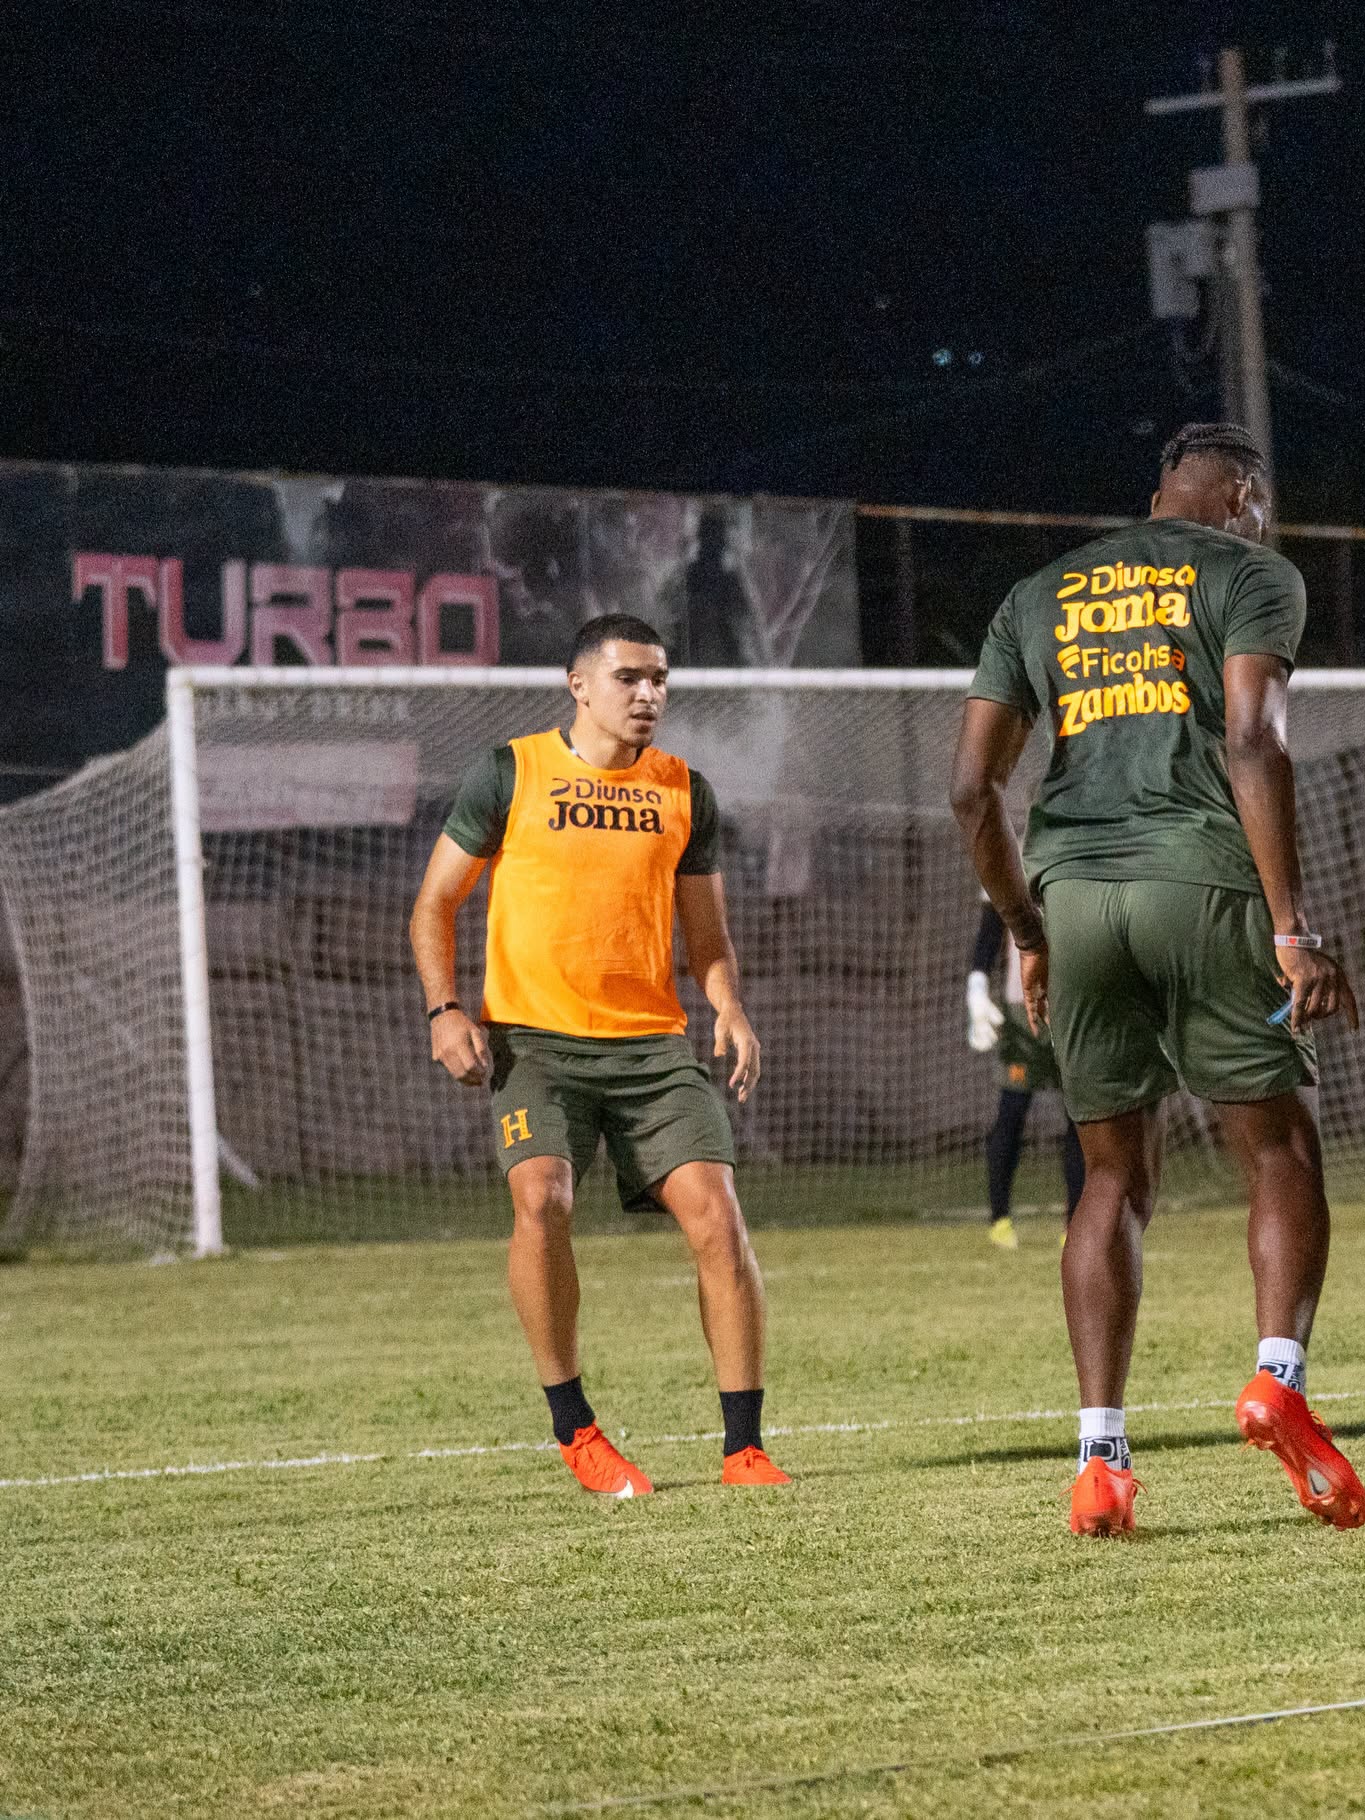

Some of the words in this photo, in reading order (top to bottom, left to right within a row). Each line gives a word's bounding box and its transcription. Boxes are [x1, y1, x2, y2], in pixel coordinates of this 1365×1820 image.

[1091, 561, 1196, 595] Diunsa
[73, 552, 500, 670] TURBO
[1054, 591, 1191, 643] Joma
[1081, 642, 1186, 678] Ficohsa
[575, 778, 662, 804] Diunsa
[548, 801, 665, 835] Joma
[501, 1108, 533, 1149] H
